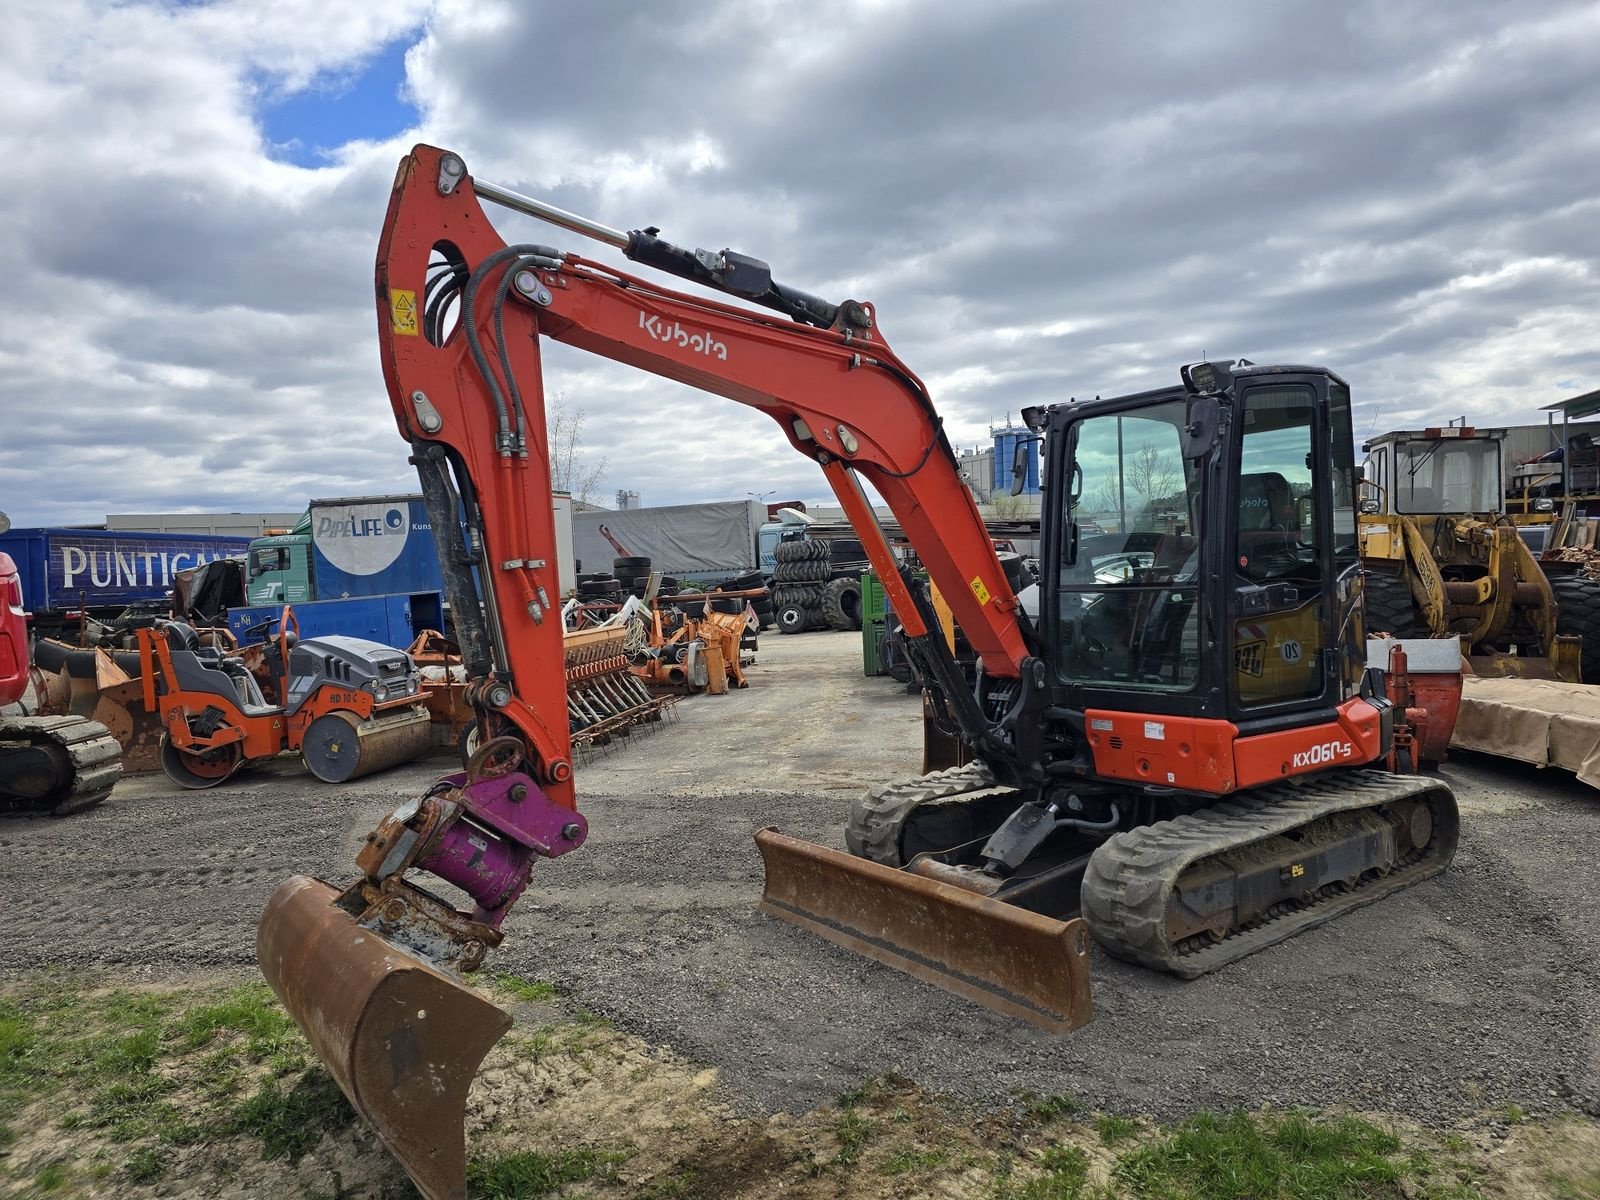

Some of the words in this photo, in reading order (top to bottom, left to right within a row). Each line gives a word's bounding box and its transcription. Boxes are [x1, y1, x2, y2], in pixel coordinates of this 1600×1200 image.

[639, 310, 727, 360] Kubota
[1240, 497, 1268, 508] ubota
[330, 693, 340, 703] HD
[343, 693, 351, 703] 10
[352, 693, 358, 701] C
[1293, 741, 1352, 768] KX060-5
